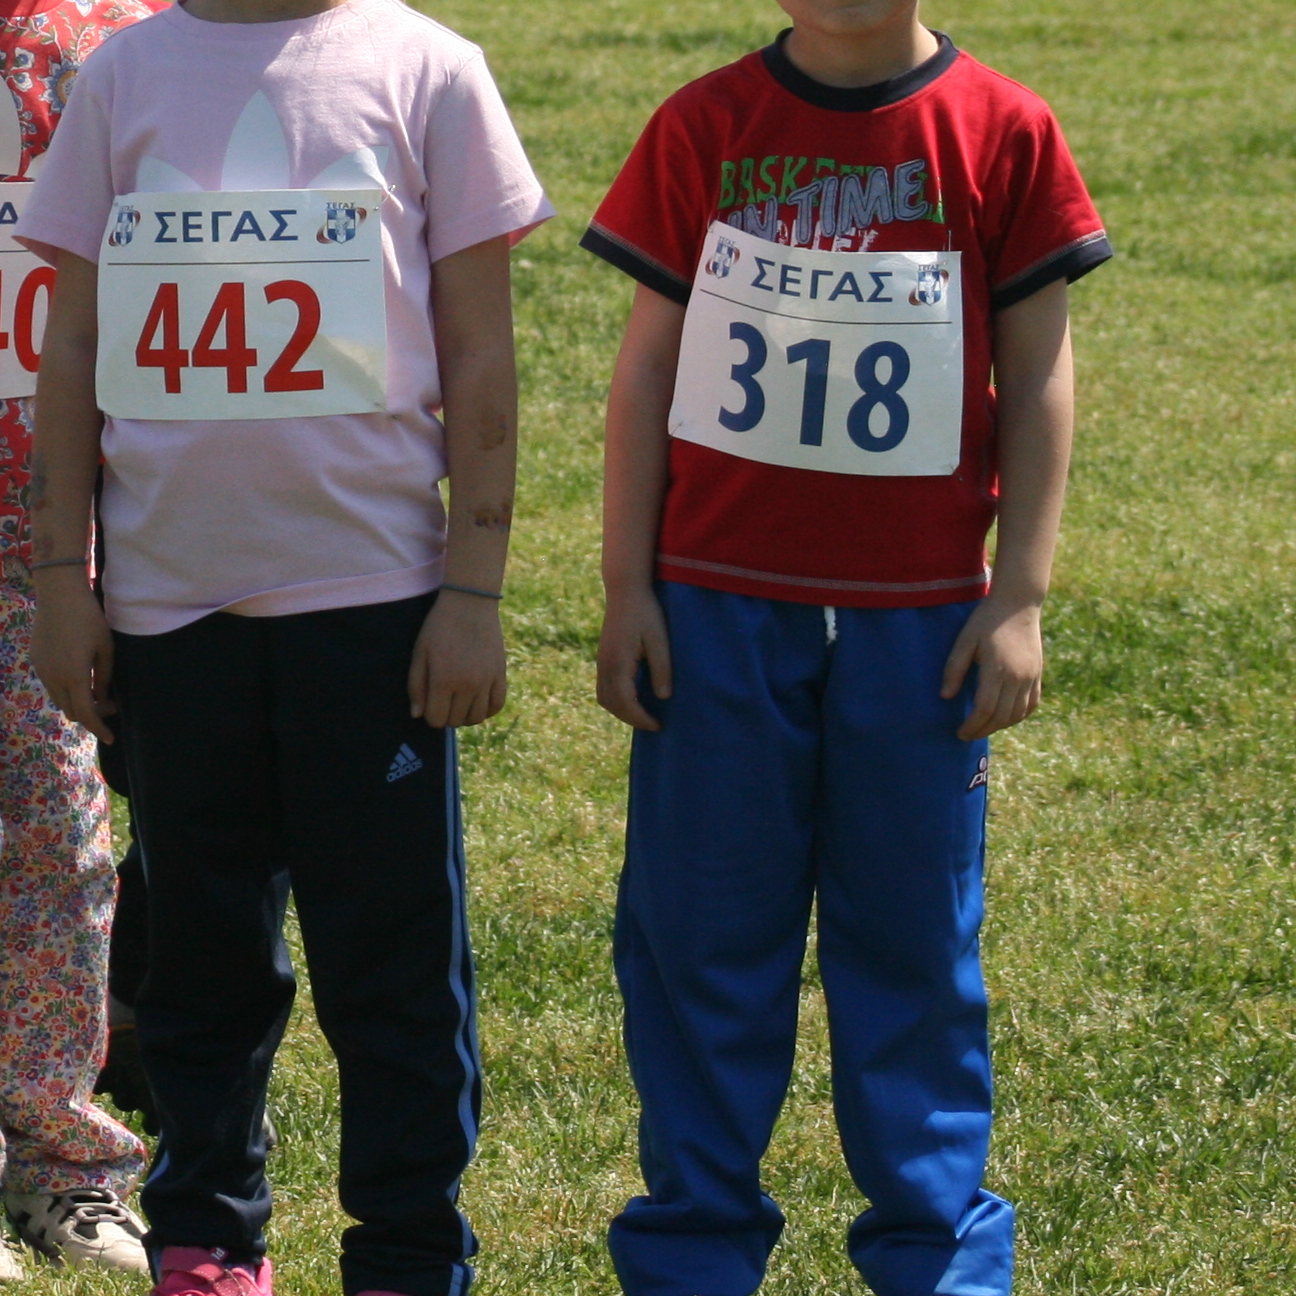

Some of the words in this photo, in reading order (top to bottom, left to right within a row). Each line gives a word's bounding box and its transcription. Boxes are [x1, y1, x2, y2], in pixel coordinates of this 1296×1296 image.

[153, 209, 299, 244] ΣΕΓΑΣ
[786, 158, 930, 245] TIME
[749, 255, 894, 304] ΣΕΓΑΣ
[134, 279, 325, 395] 442
[717, 321, 911, 453] 318
[386, 758, 424, 783] adidas
